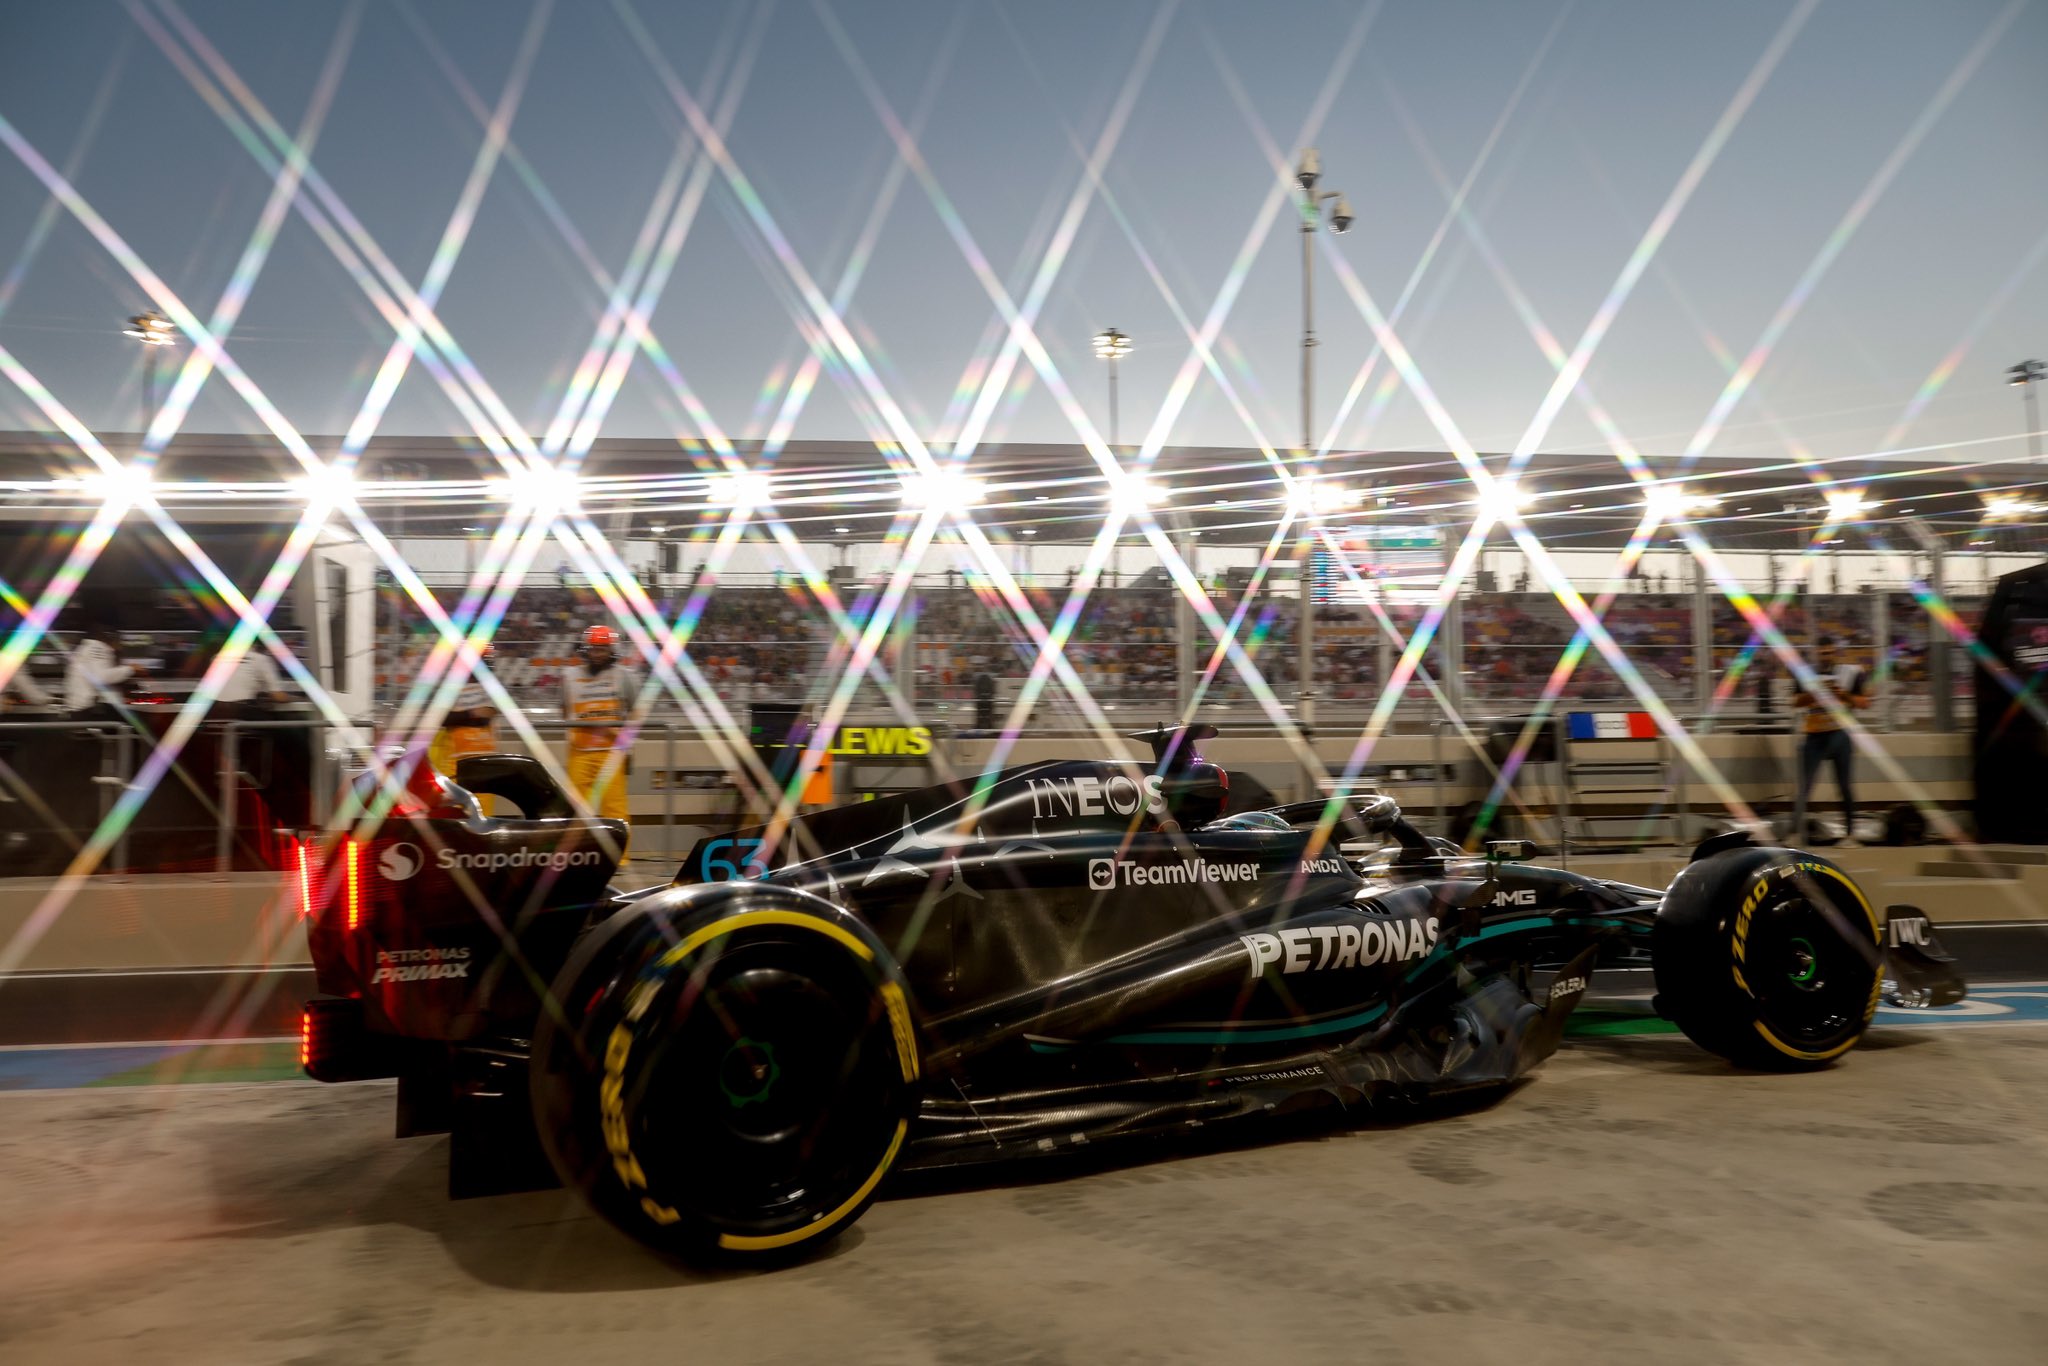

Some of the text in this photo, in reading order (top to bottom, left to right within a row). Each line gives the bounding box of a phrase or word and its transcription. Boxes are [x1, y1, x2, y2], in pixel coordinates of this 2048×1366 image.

[824, 727, 932, 755] LEWIS
[1025, 774, 1168, 819] INEOS
[435, 847, 601, 873] Snapdragon
[702, 838, 770, 882] 63
[1118, 858, 1260, 886] TeamViewer
[1301, 859, 1331, 874] AMD
[1732, 878, 1768, 965] ZERO
[376, 948, 471, 963] PETRONAS
[1240, 916, 1440, 979] PETRONAS
[371, 961, 472, 984] PRIMAX
[1225, 1066, 1324, 1082] PERFORMANCE
